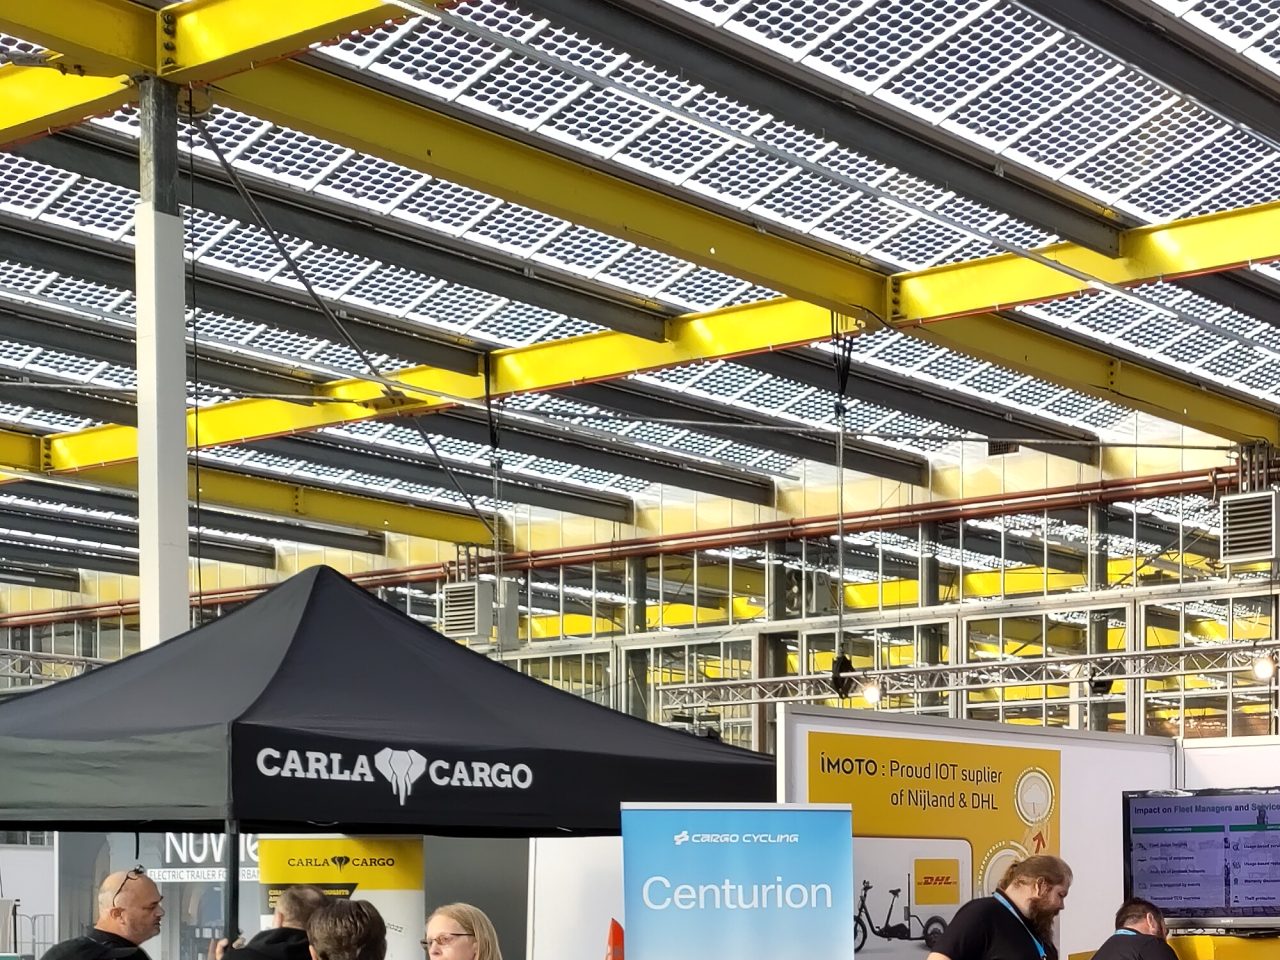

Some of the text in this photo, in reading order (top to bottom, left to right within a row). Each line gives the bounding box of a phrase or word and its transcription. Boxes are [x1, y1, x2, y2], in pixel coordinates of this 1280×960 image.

[256, 748, 533, 789] CARLA CARGO
[890, 760, 931, 780] Proud
[935, 763, 958, 781] IOT
[961, 764, 1002, 785] suplier
[890, 789, 998, 811] of Nijland & DHL
[1134, 805, 1160, 816] Impact
[1174, 805, 1194, 813] Fleet
[1195, 804, 1232, 815] Managers
[1234, 803, 1249, 812] and
[1251, 803, 1280, 811] Service
[287, 858, 395, 867] CARLA CARGO
[187, 869, 216, 881] TRAILER
[241, 869, 259, 880] RBA
[919, 876, 954, 885] DHL
[642, 876, 833, 910] Centurion
